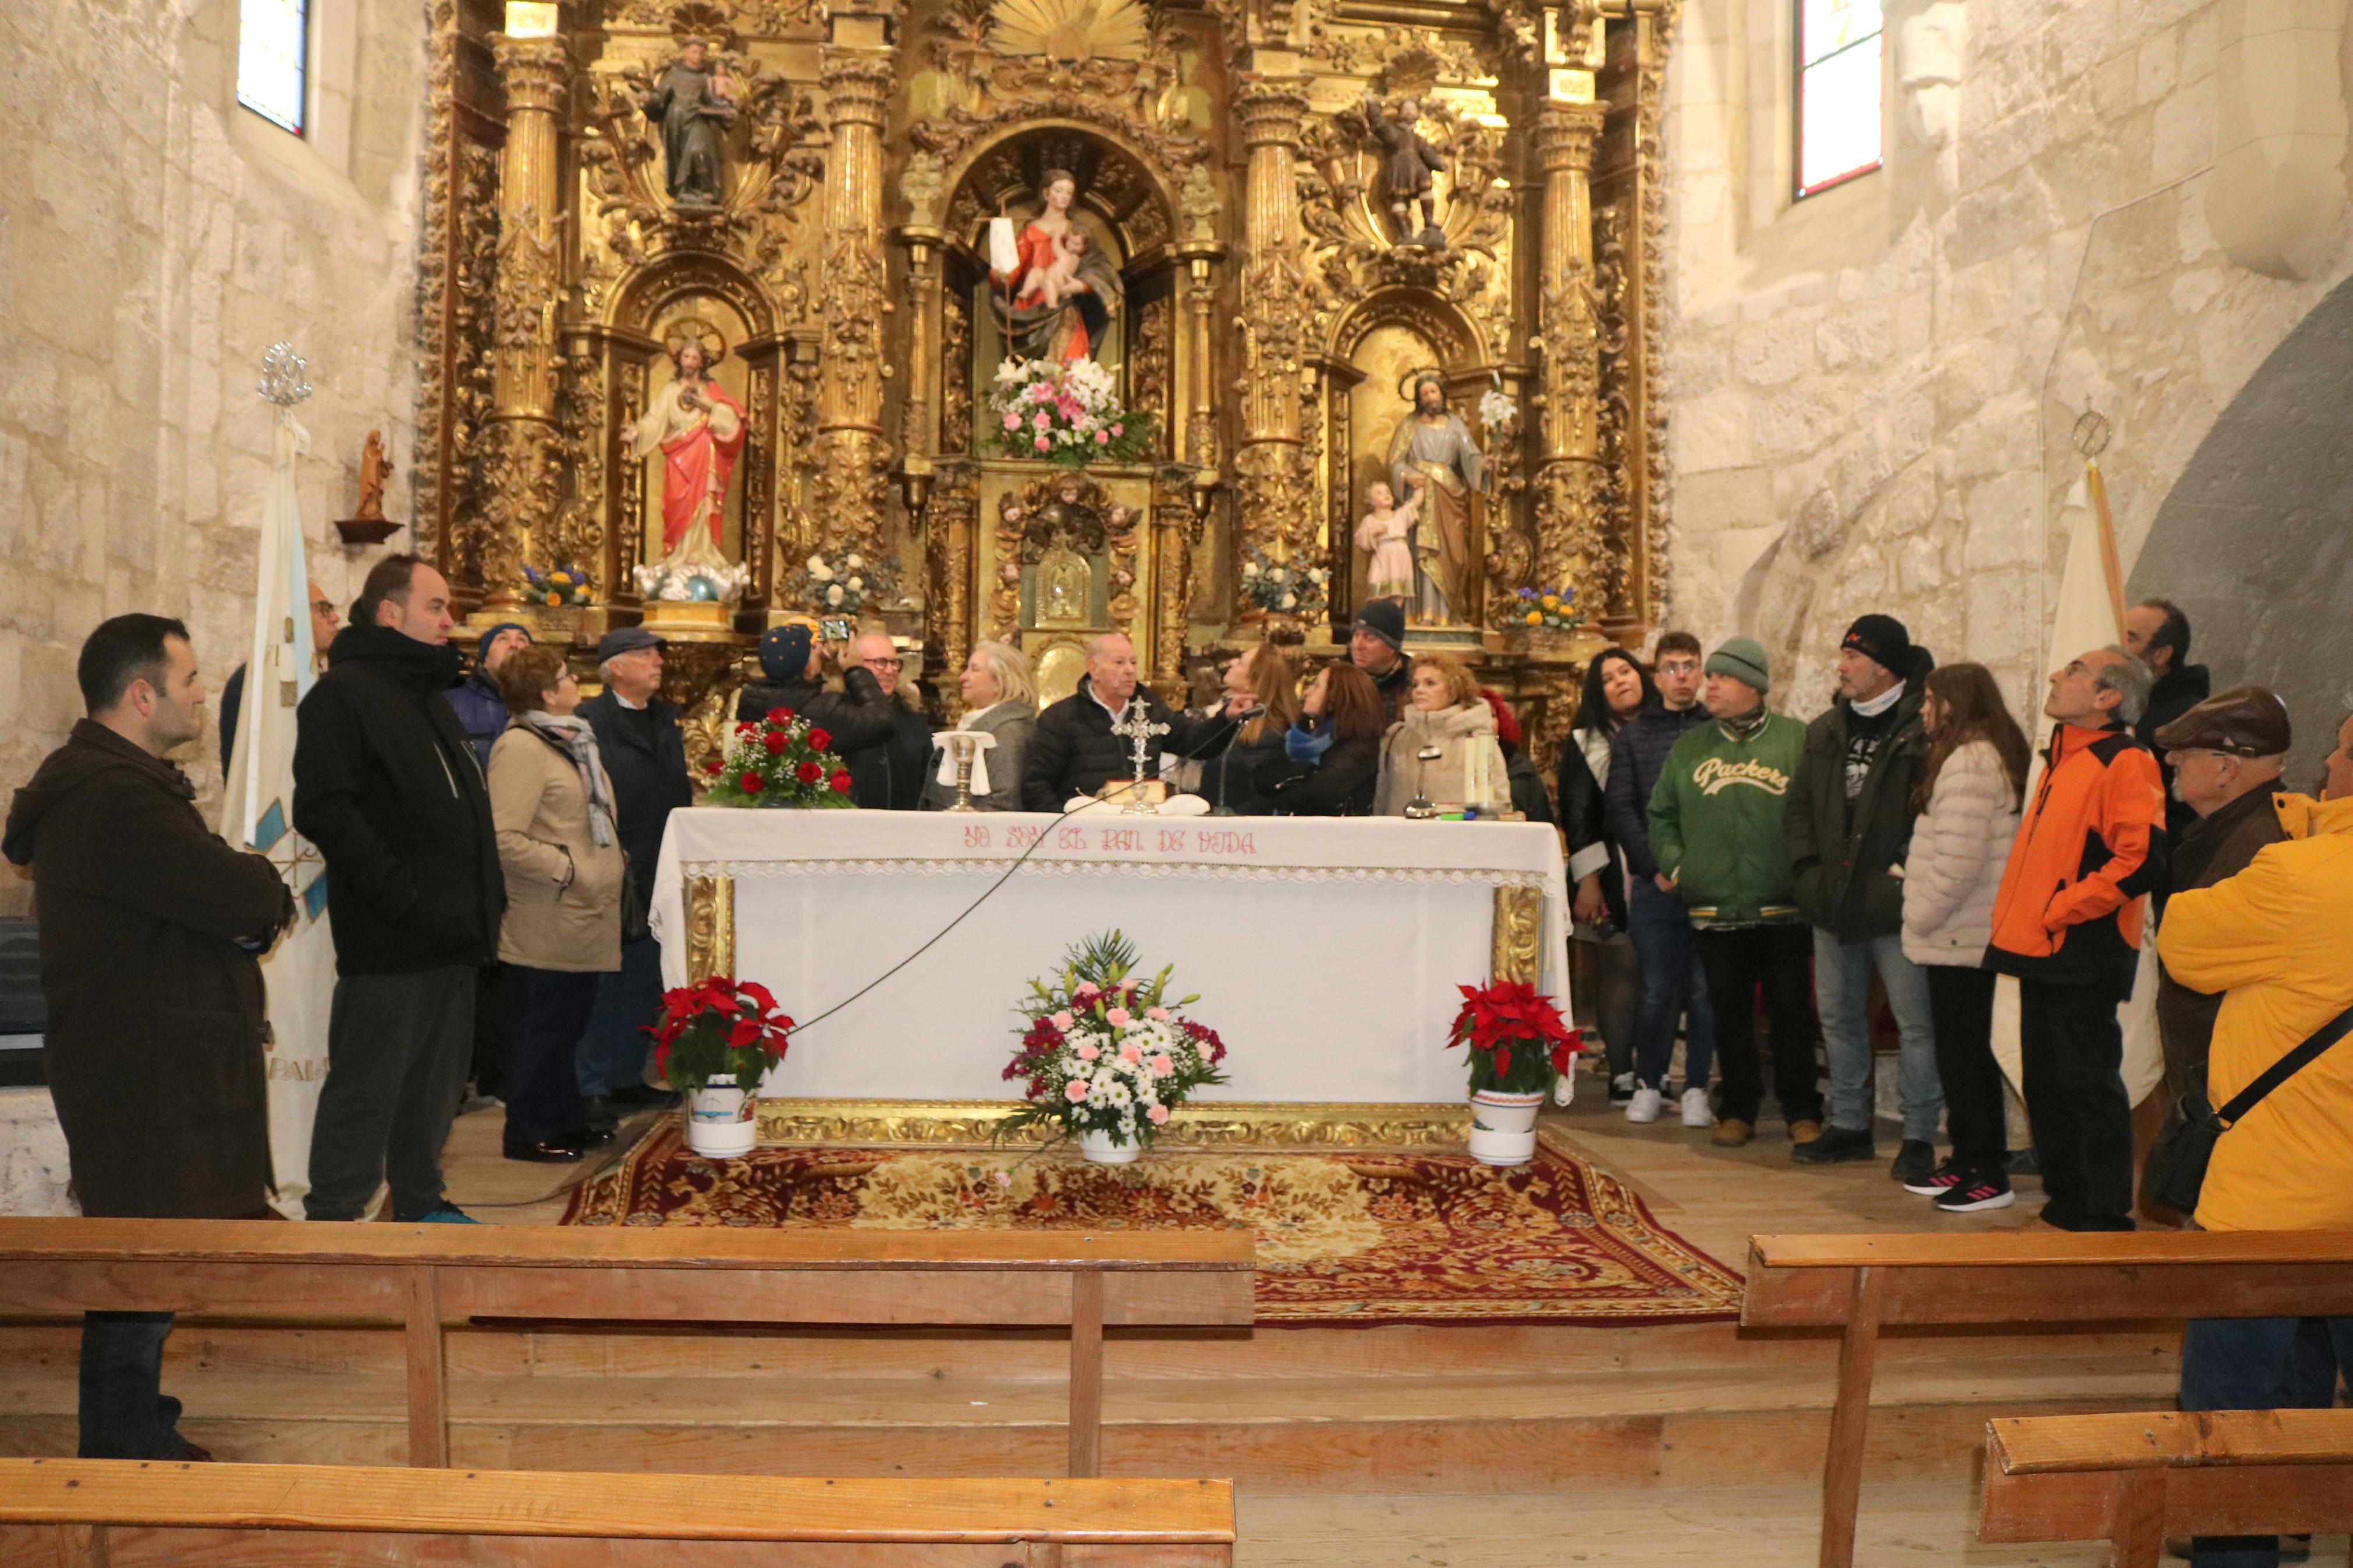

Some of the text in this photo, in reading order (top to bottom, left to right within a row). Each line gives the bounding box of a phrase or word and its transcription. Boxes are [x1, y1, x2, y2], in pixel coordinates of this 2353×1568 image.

[1694, 757, 1790, 788] Packers
[964, 826, 991, 848] YO
[1007, 826, 1045, 848] SOY
[1101, 829, 1145, 851] PAN
